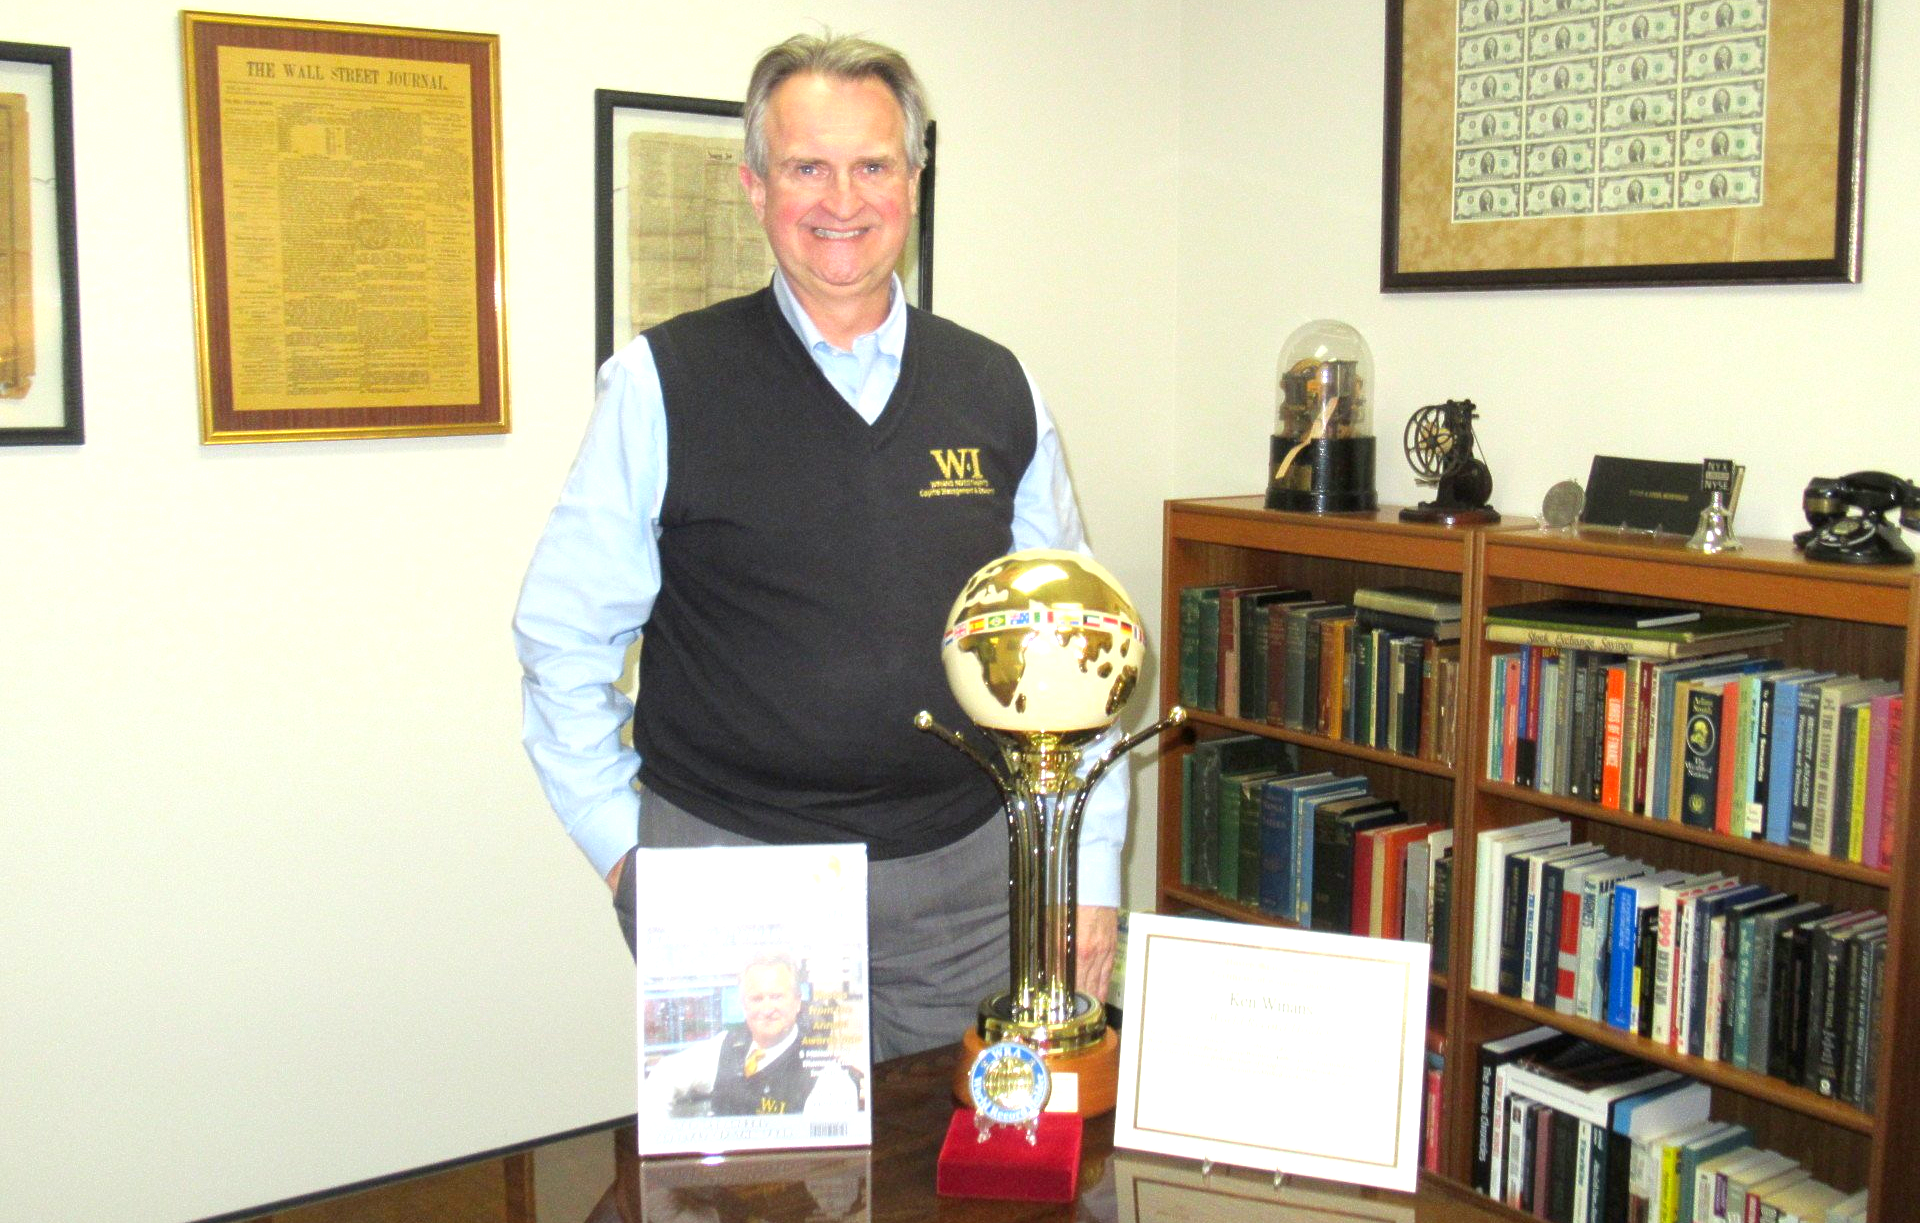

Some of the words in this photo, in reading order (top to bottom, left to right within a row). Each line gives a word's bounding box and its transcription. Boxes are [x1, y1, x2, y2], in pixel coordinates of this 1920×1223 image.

[246, 61, 275, 78] THE
[283, 63, 325, 81] WALL
[330, 66, 380, 84] STREET
[1230, 992, 1256, 1009] Ken
[1262, 996, 1313, 1015] Winans
